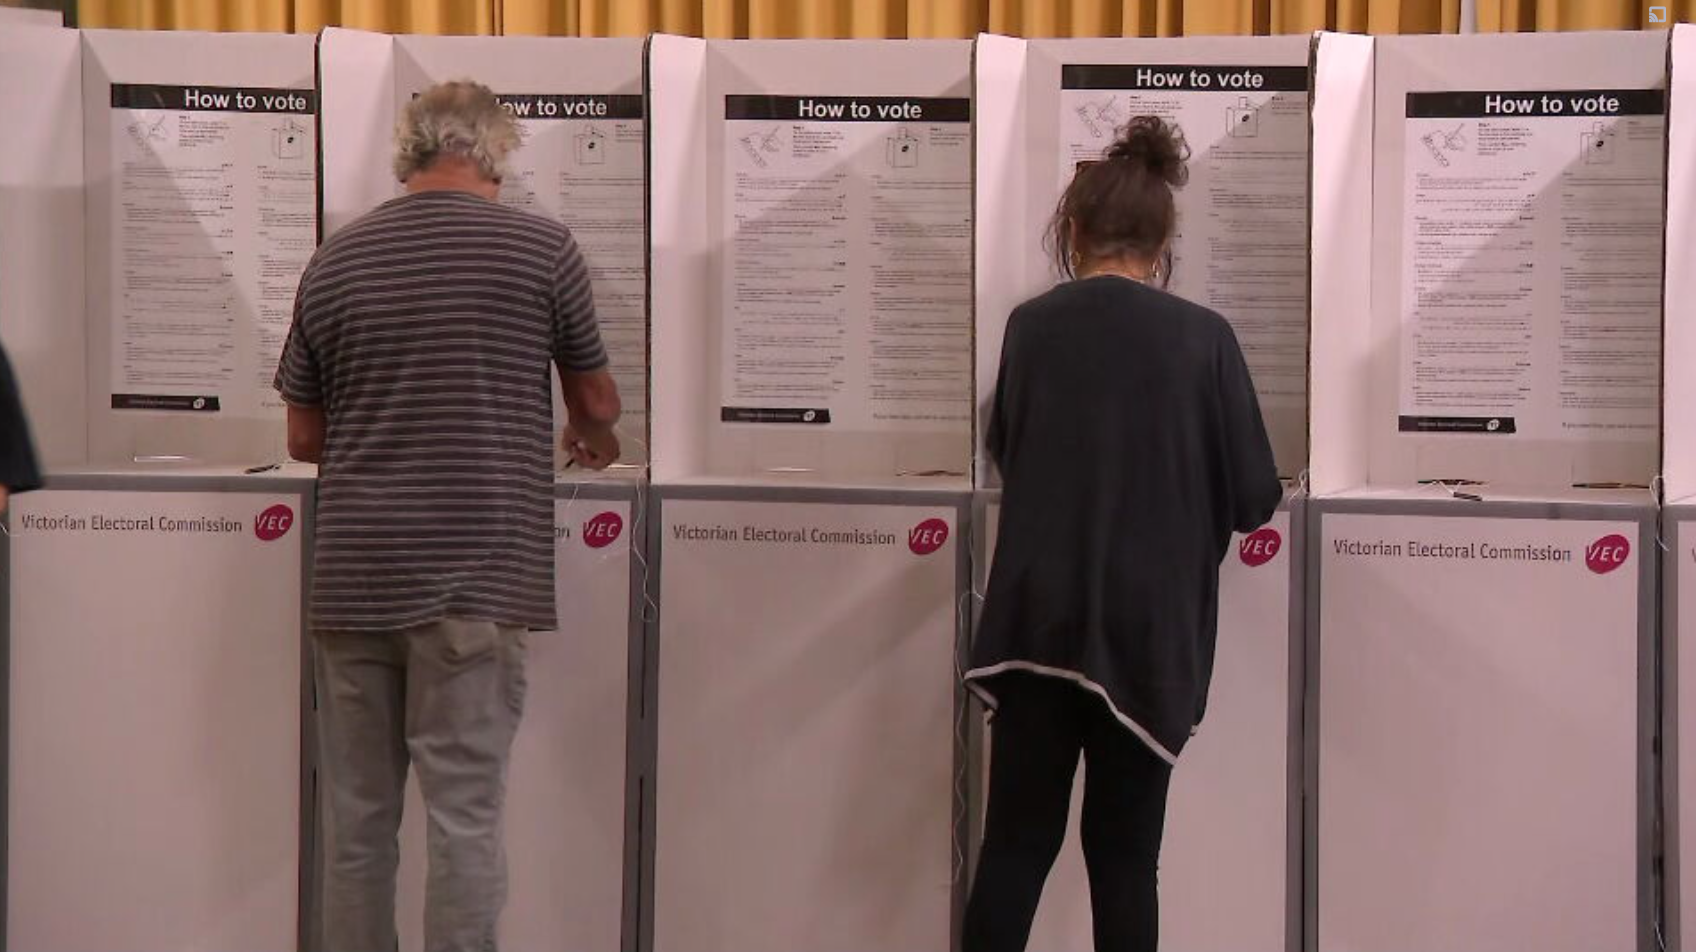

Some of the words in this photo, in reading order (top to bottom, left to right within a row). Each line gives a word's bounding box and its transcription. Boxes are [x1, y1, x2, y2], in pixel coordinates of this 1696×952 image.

[1136, 69, 1184, 87] How
[1190, 70, 1211, 87] to
[1218, 71, 1264, 88] vote
[185, 89, 230, 108] How
[236, 91, 256, 109] to
[262, 93, 307, 110] vote
[495, 98, 531, 115] ow
[536, 98, 557, 115] to
[563, 99, 607, 116] vote
[799, 99, 845, 118] How
[850, 101, 870, 118] to
[877, 102, 922, 119] vote
[1484, 95, 1535, 114] How
[1541, 95, 1563, 113] to
[1571, 95, 1620, 113] vote
[21, 514, 86, 531] Victorian
[91, 515, 154, 531] Electoral
[158, 516, 243, 532] Commission
[255, 514, 289, 531] VEC
[583, 522, 618, 538] VEC
[673, 525, 738, 541] Victorian
[743, 526, 806, 543] Electoral
[811, 528, 896, 545] Commission
[909, 528, 943, 545] VEC
[1240, 539, 1275, 555] VEC
[1333, 539, 1401, 556] Victorian
[1408, 541, 1474, 558] Electoral
[1480, 543, 1571, 561] Commission
[1585, 544, 1624, 562] VEC
